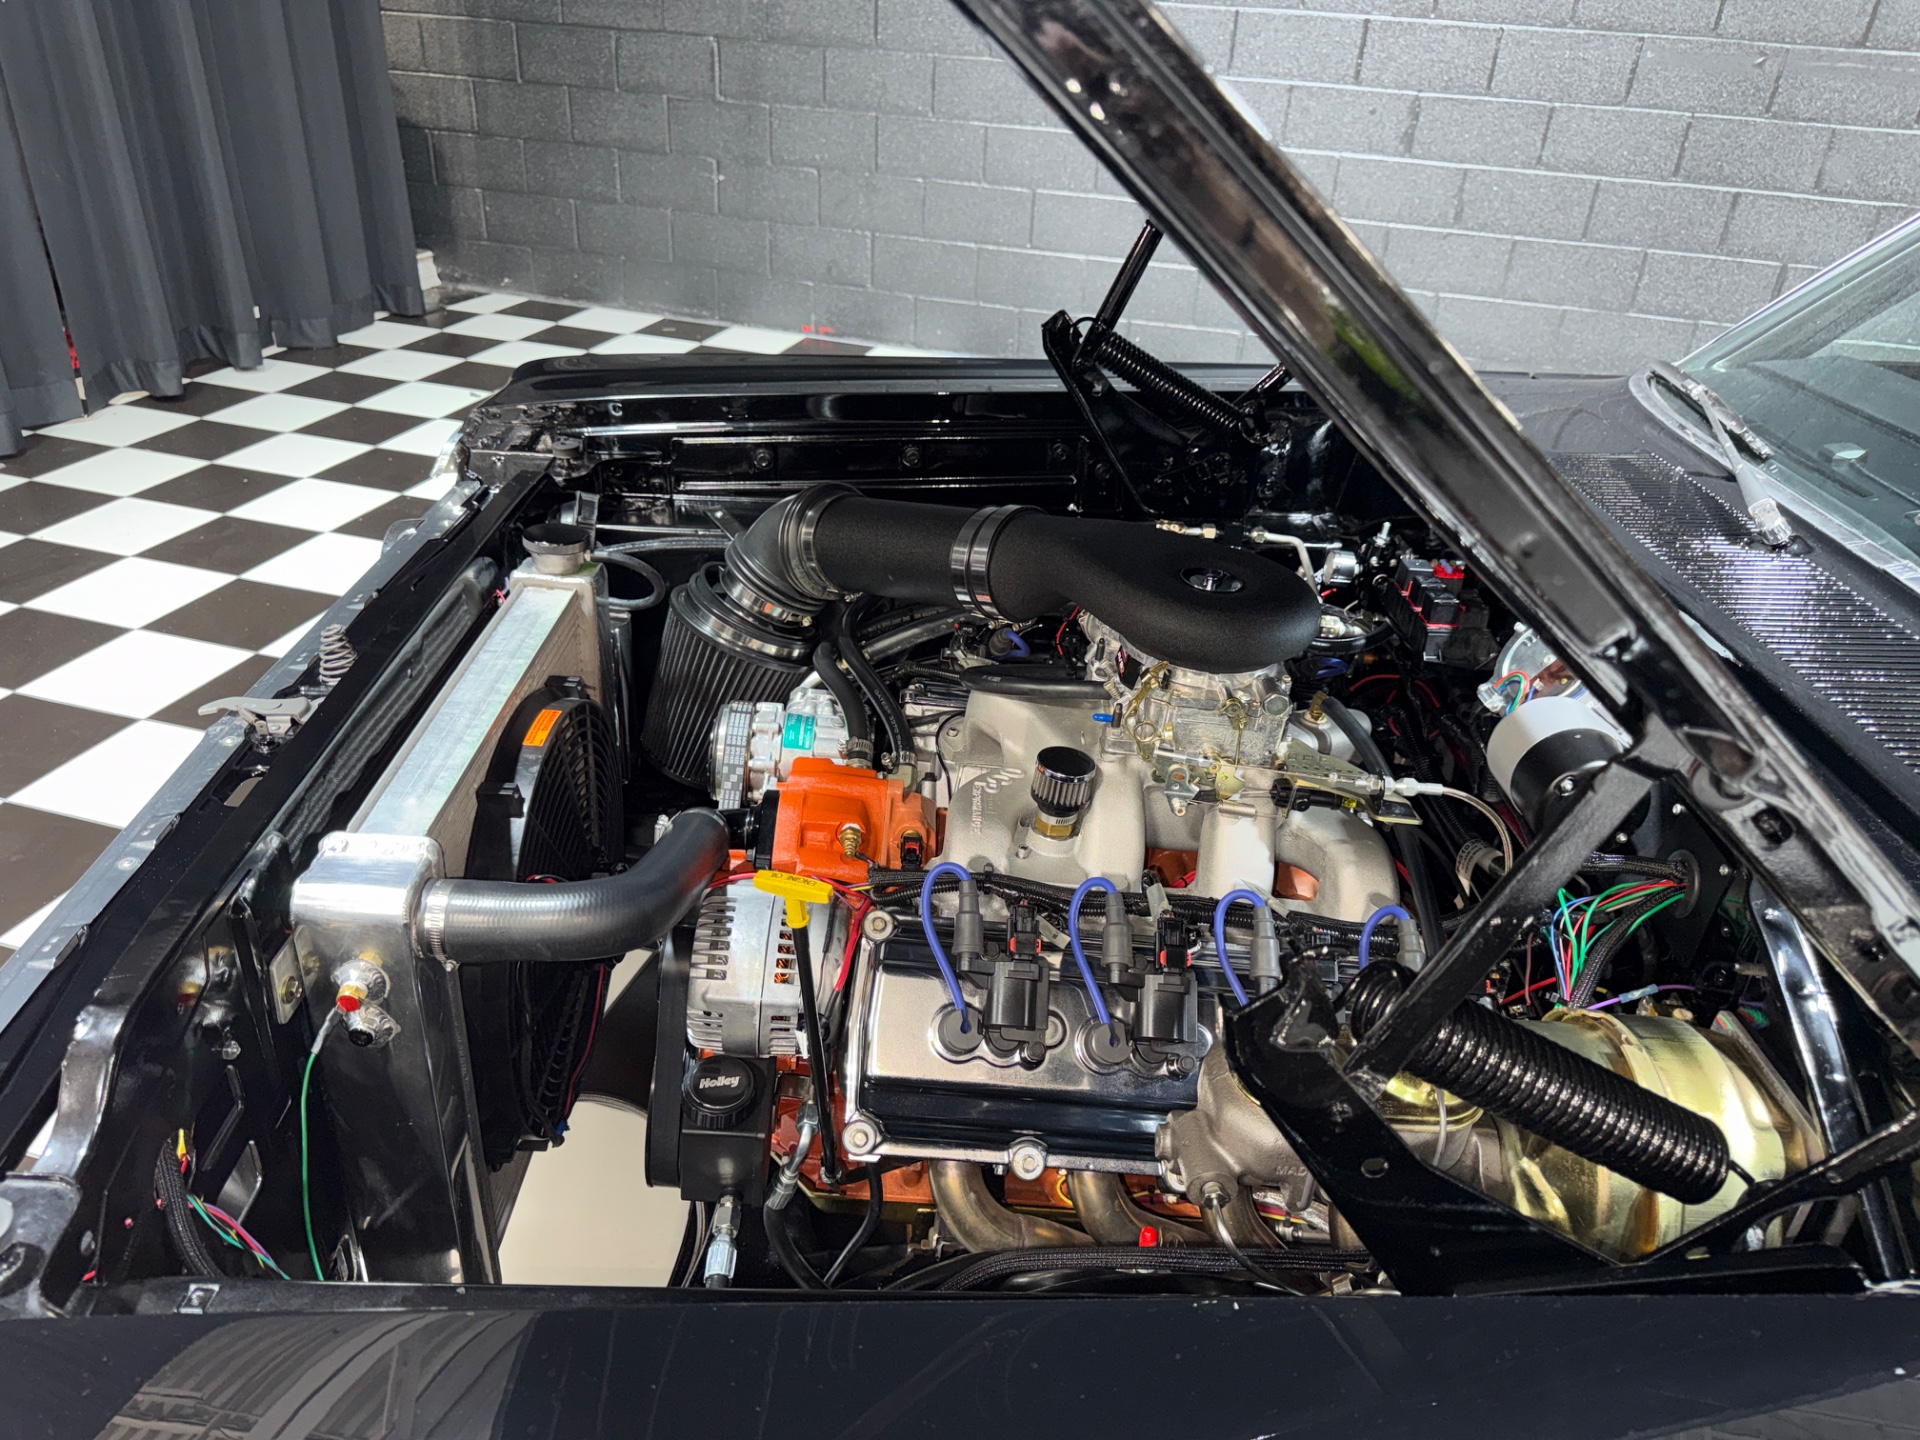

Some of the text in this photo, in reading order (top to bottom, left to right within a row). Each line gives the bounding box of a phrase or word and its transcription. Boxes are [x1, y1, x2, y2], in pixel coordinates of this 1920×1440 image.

[785, 874, 818, 887] ENGINE
[699, 1076, 740, 1090] Holley
[1276, 1164, 1308, 1177] MAD
